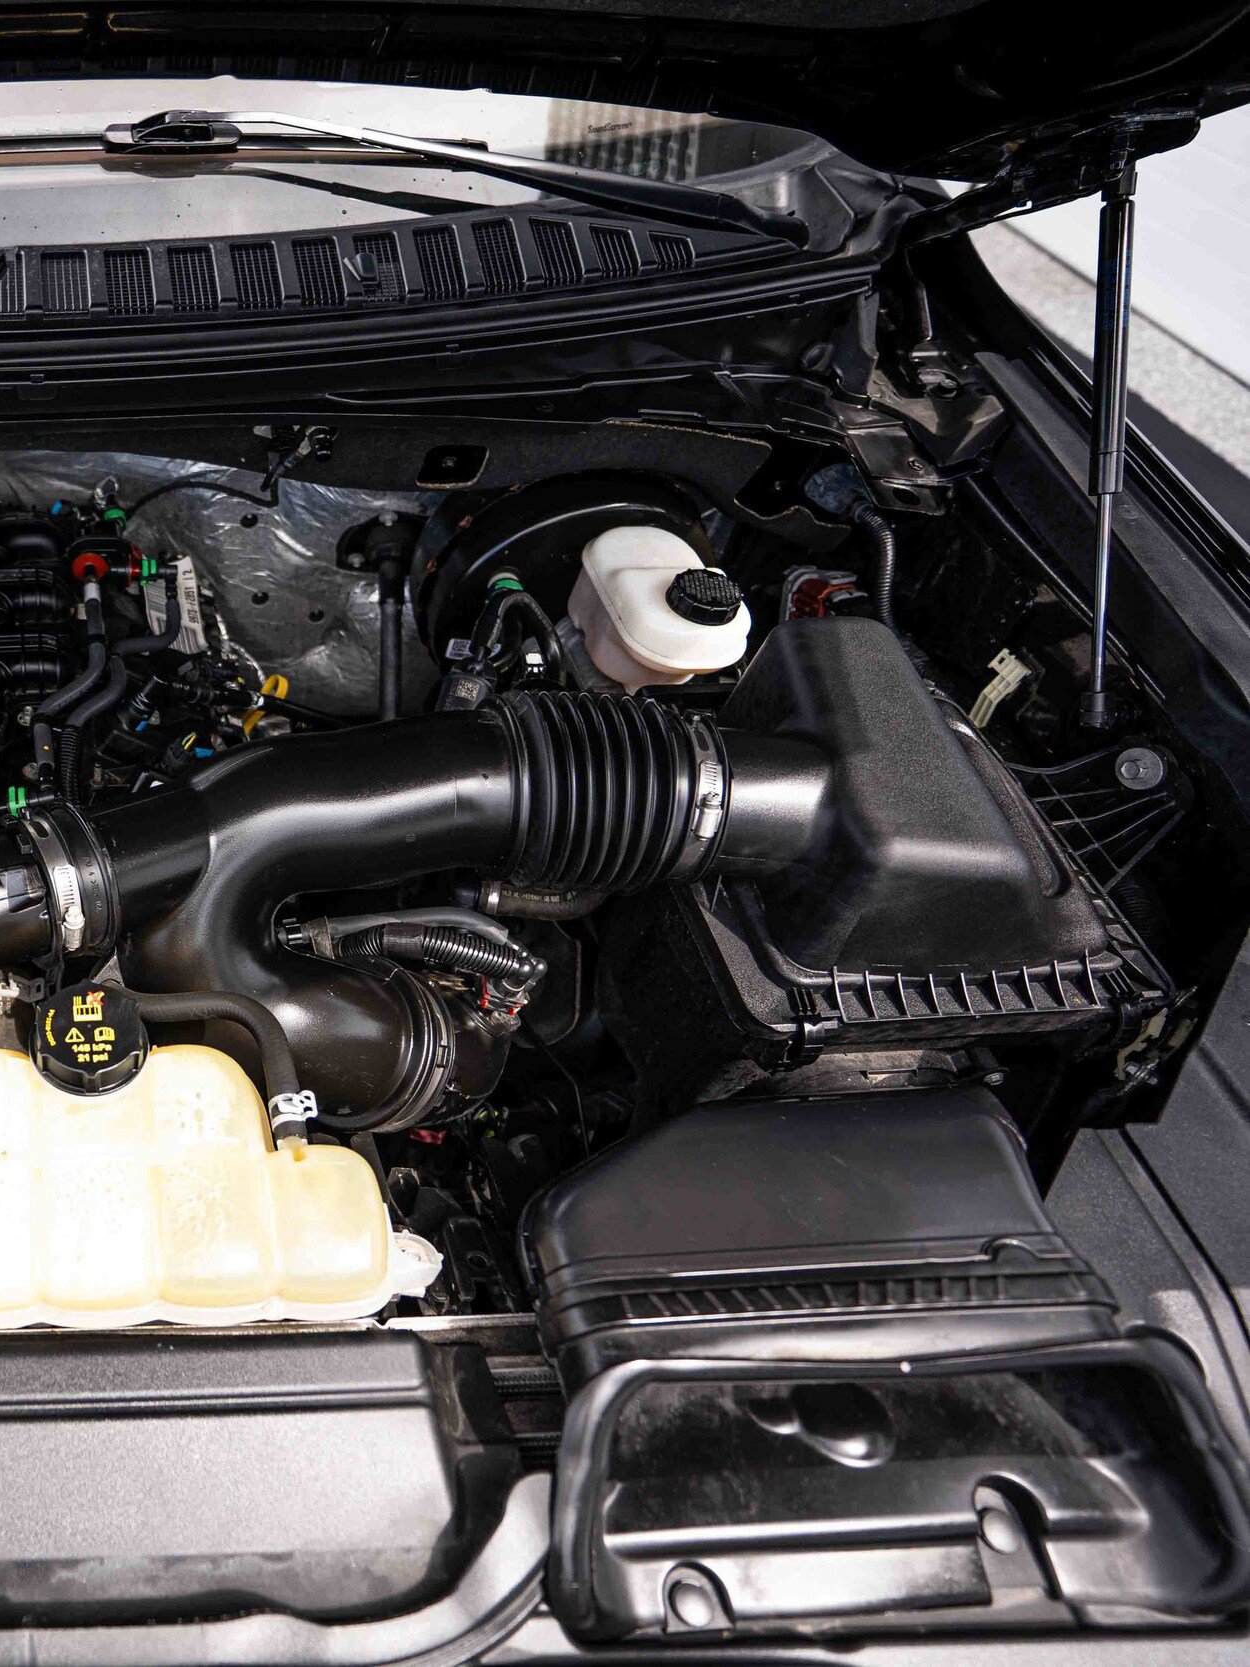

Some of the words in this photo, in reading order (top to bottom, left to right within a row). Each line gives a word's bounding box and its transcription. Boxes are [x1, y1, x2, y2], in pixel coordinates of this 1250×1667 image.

[71, 1043, 91, 1052] 145
[92, 1042, 113, 1052] kPa
[77, 1053, 90, 1063] 21
[92, 1052, 109, 1063] psi
